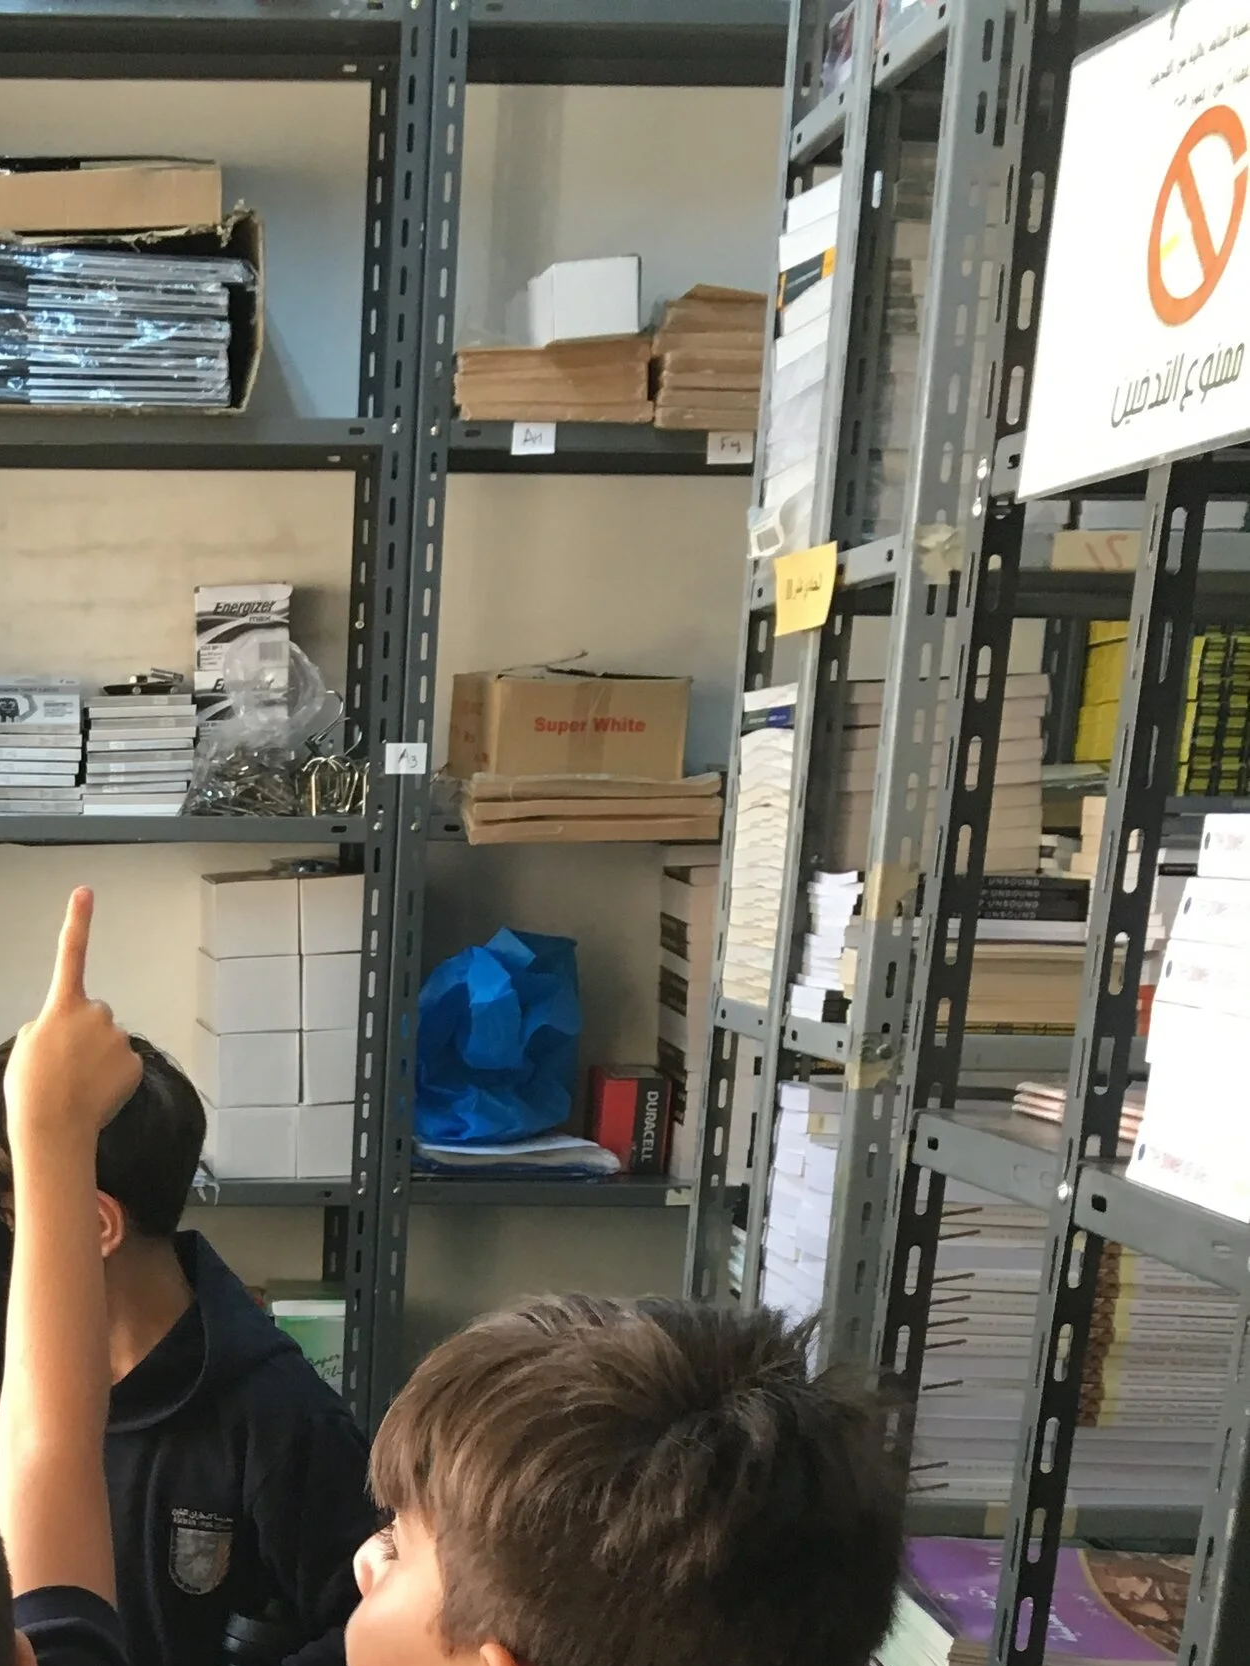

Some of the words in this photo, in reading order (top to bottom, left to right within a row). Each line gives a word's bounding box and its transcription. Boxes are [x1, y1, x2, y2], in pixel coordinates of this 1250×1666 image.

[1111, 352, 1186, 428] التدخين
[1180, 343, 1245, 412] ممنوع
[212, 600, 277, 618] Energizer
[534, 716, 588, 736] Super
[593, 716, 646, 733] White
[641, 1090, 659, 1163] DURACELL
